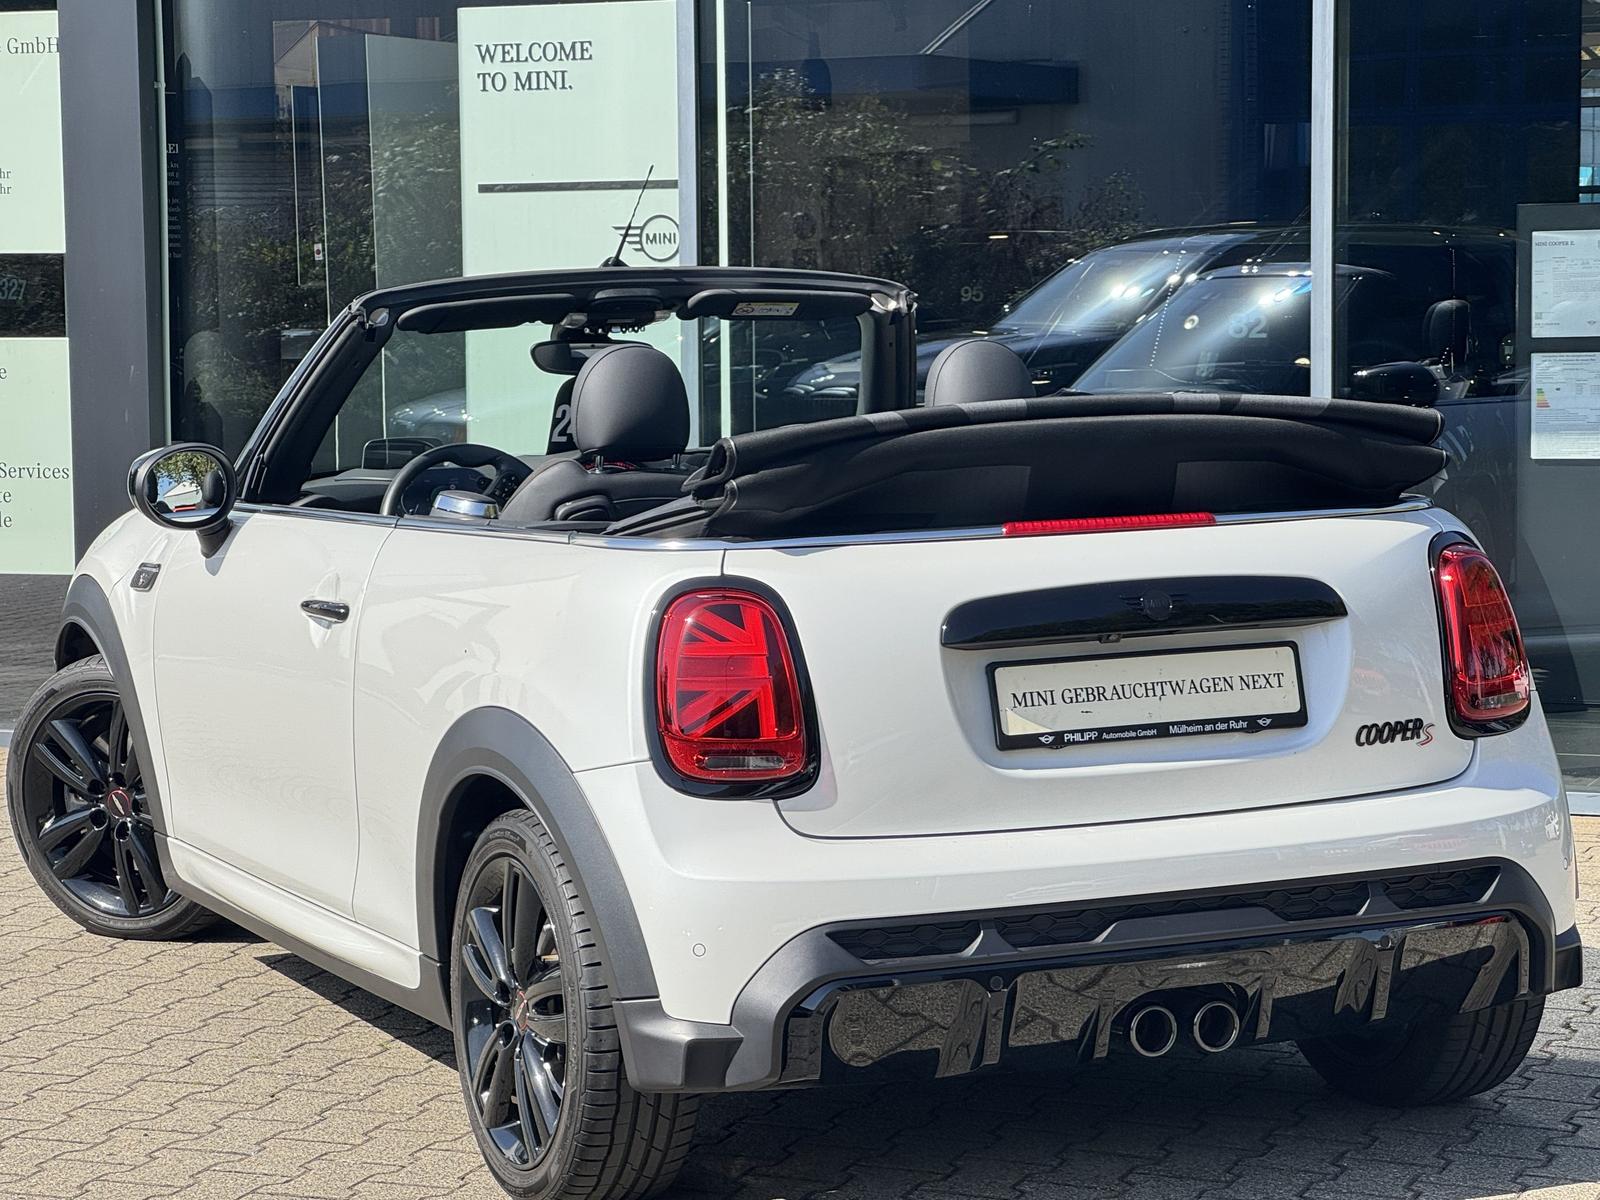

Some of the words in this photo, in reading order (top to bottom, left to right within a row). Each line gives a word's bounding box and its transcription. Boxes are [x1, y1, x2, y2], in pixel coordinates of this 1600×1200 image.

[7, 36, 59, 54] GmbH
[475, 41, 592, 64] WELCOME
[477, 72, 507, 92] TO
[513, 70, 573, 91] MINI.
[645, 232, 676, 245] MINI
[960, 286, 984, 302] 95
[0, 461, 70, 480] Services
[1011, 690, 1057, 709] MINI
[1061, 675, 1234, 705] GEBRAUCHTWAGEN
[1238, 672, 1285, 692] NEXT
[1063, 731, 1098, 743] PHILIPP
[1102, 730, 1136, 740] Automobile
[1137, 728, 1157, 738] GmbH
[1169, 723, 1203, 734] Mülheim
[1204, 723, 1214, 732] an
[1215, 721, 1228, 731] der
[1229, 719, 1248, 730] Ruhr
[1355, 717, 1424, 747] COOPER
[1416, 722, 1436, 747] S
